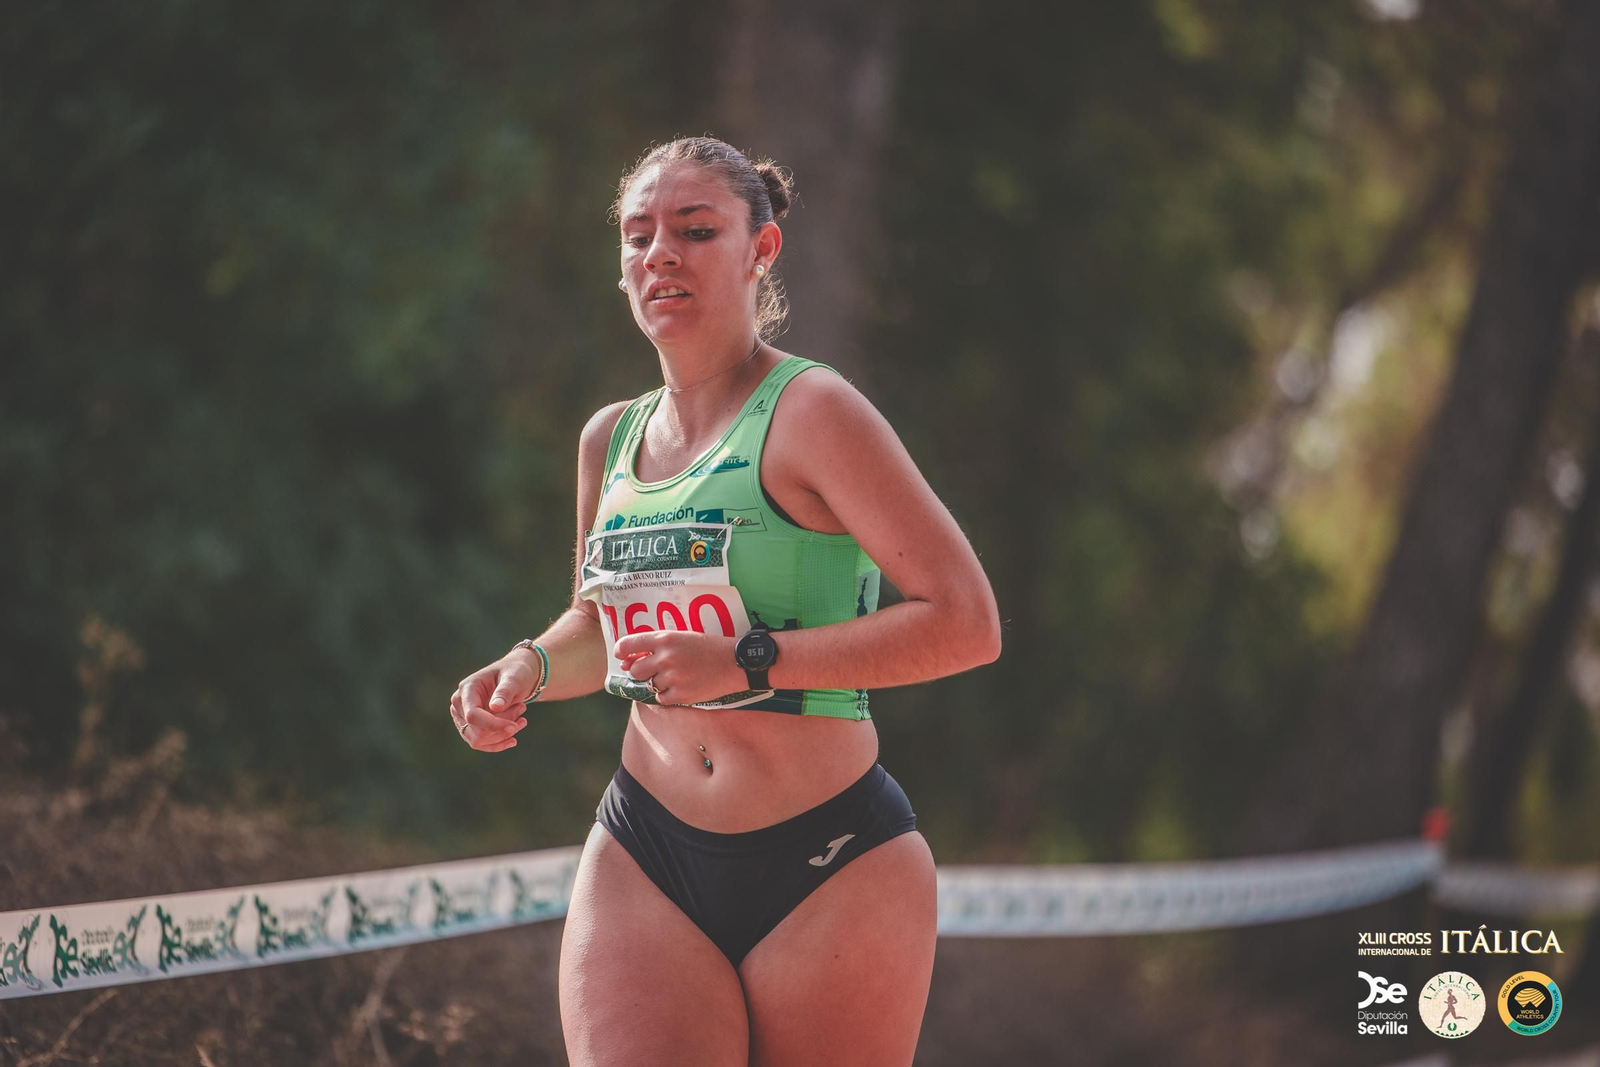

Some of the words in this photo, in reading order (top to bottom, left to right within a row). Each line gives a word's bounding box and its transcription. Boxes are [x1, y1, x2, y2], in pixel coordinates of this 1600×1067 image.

[628, 505, 695, 528] Fundación
[611, 535, 679, 561] ITÁLICA
[632, 571, 655, 581] BUENO
[655, 570, 672, 579] RUIZ
[659, 579, 686, 587] INTERIOR
